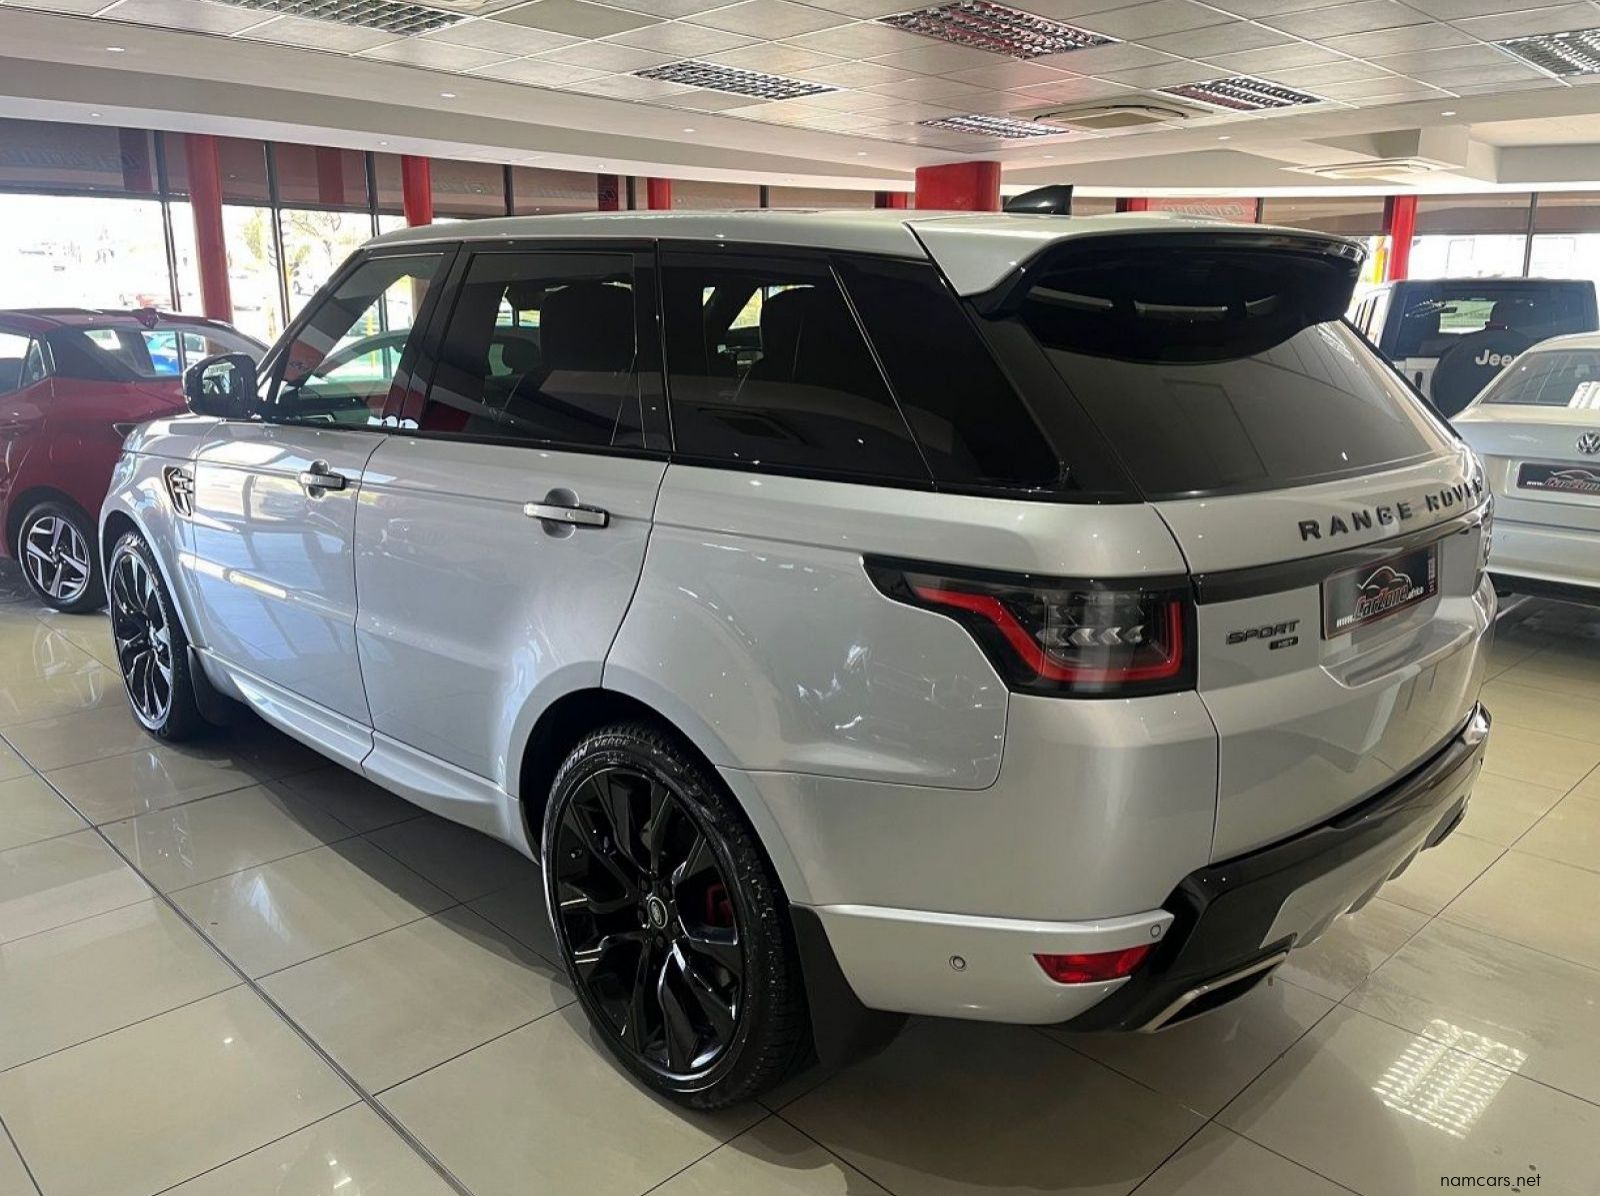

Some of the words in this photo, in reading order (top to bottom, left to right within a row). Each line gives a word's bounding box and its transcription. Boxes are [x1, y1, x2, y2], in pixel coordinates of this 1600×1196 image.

[1475, 349, 1519, 368] Jee
[1298, 501, 1412, 541] RANGE
[1226, 619, 1300, 645] SPORT
